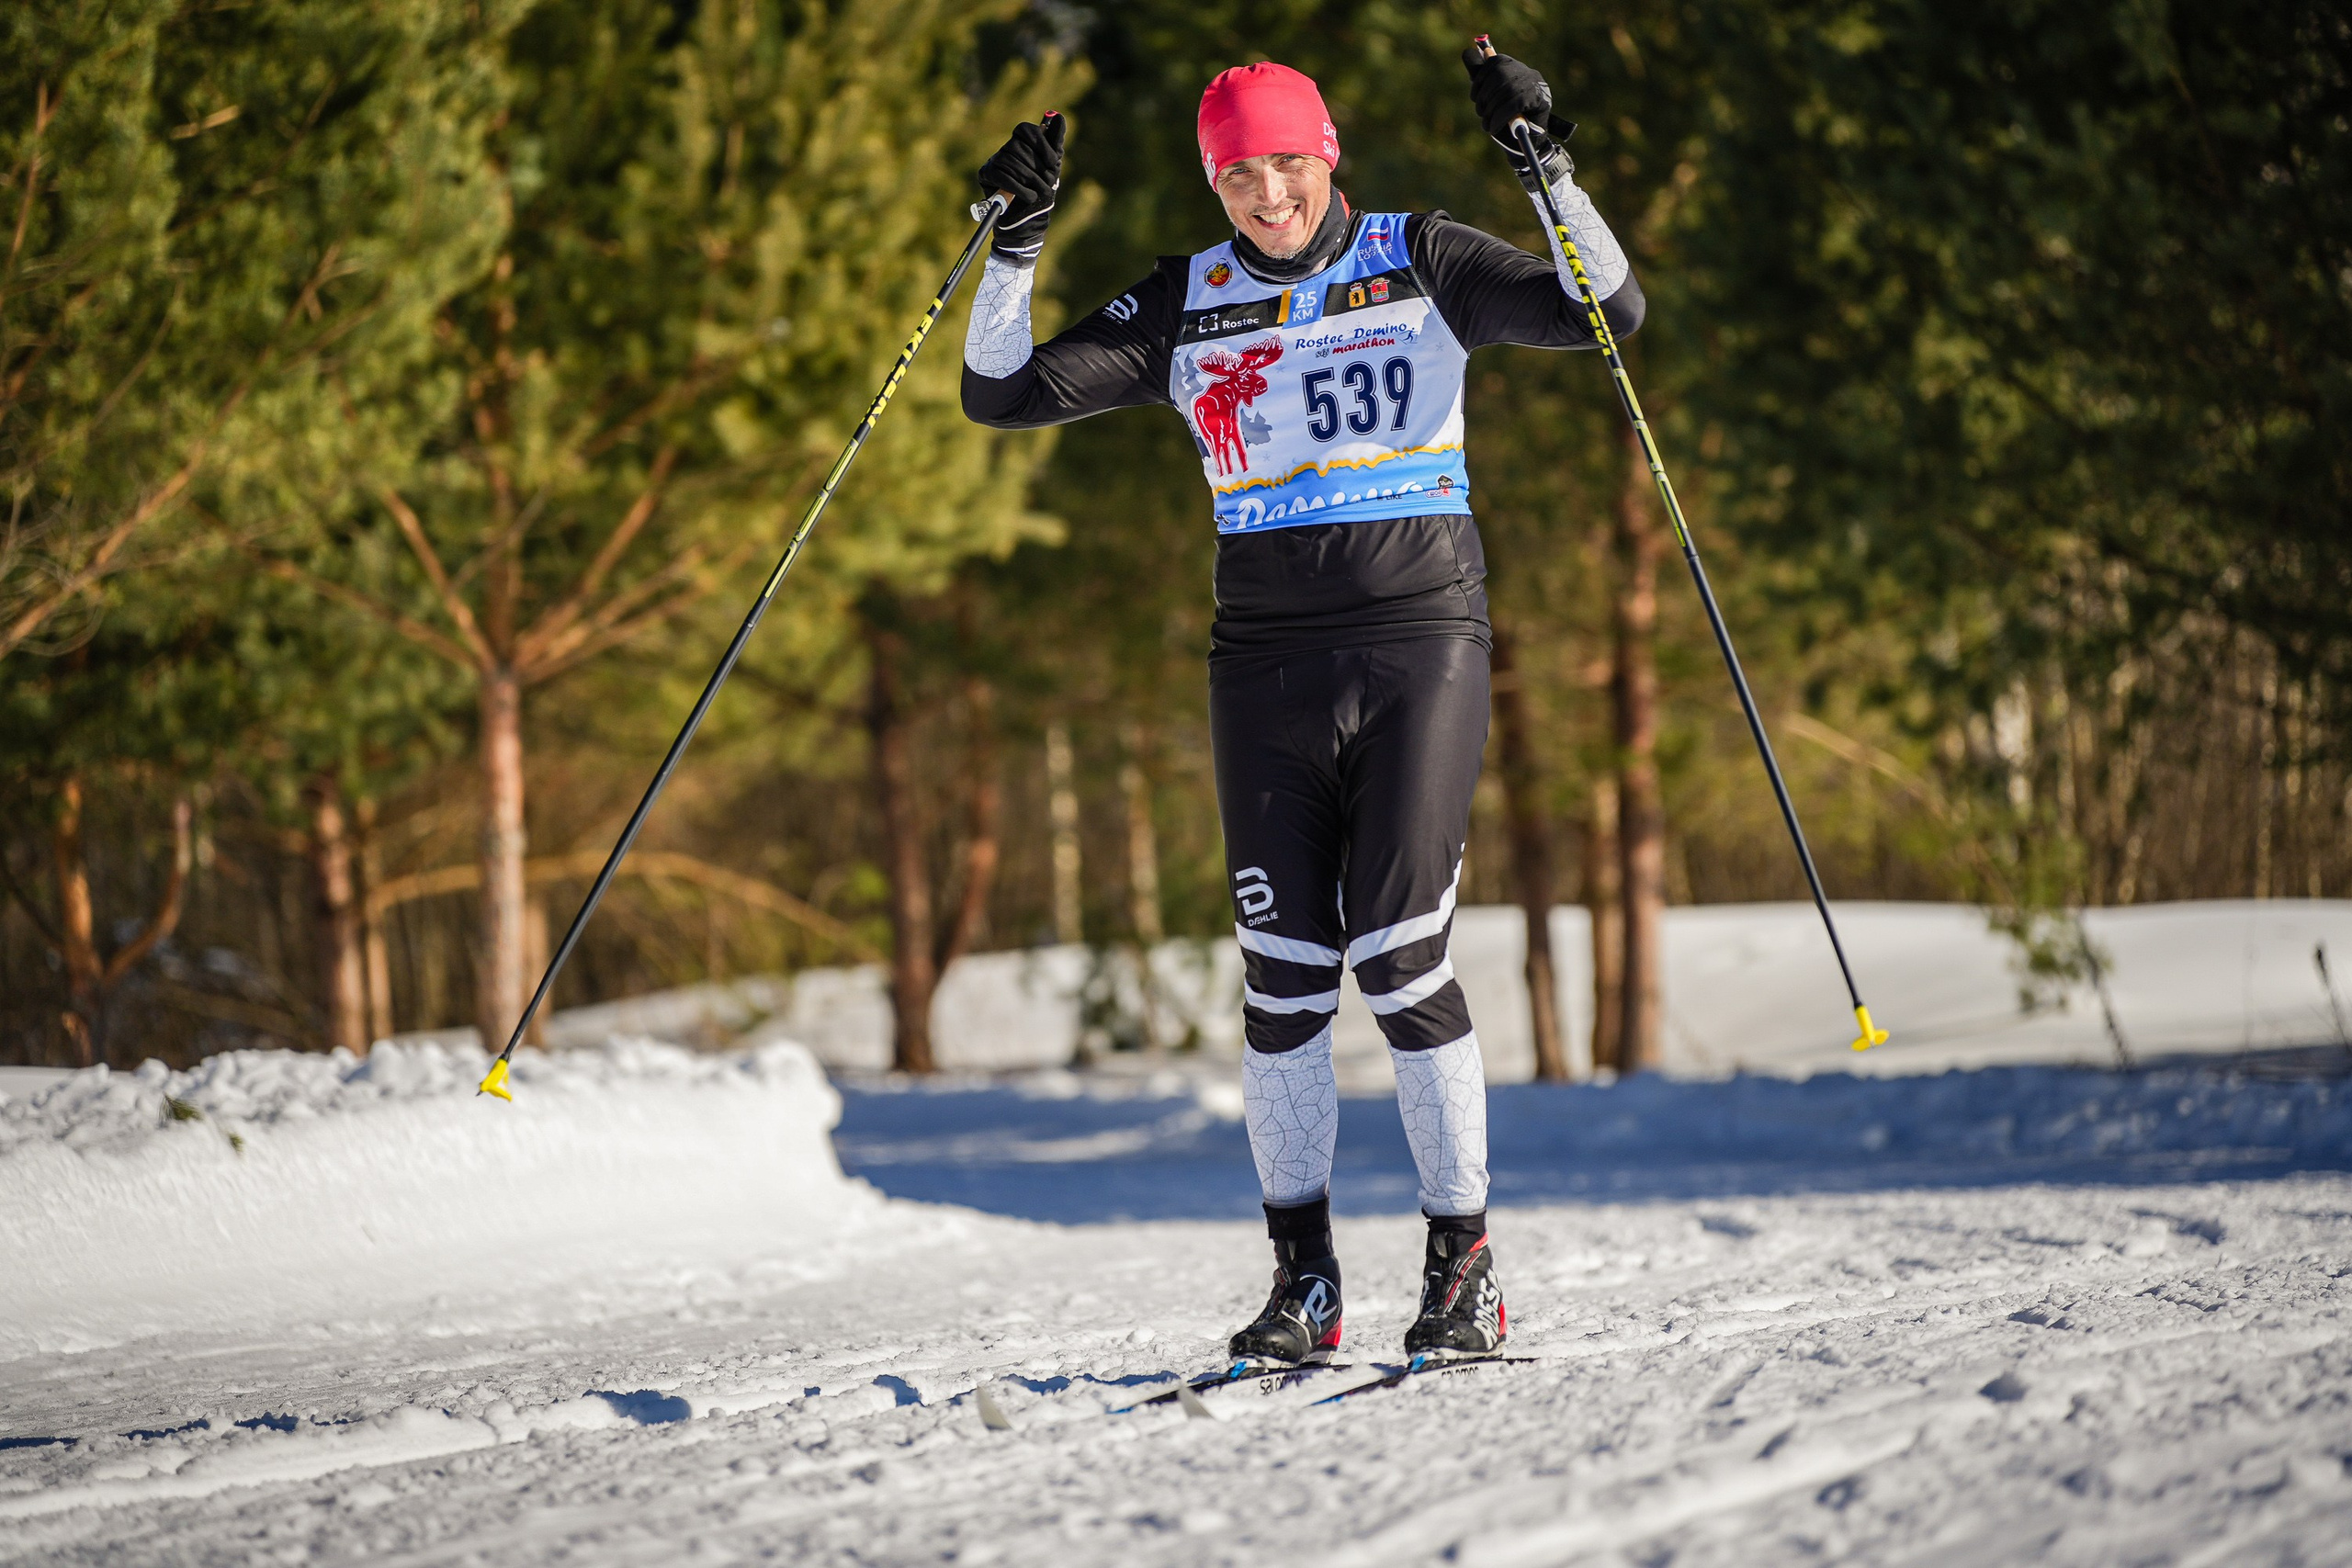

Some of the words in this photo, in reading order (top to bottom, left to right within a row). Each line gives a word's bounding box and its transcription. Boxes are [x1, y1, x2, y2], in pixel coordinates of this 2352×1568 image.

[1323, 140, 1335, 158] Ski
[1295, 290, 1317, 310] 25
[1222, 318, 1260, 330] Rostec
[1292, 308, 1314, 322] KM
[1295, 333, 1343, 350] Rostec
[1353, 322, 1408, 339] Demino
[1332, 337, 1396, 355] marathon
[1301, 355, 1415, 443] 539
